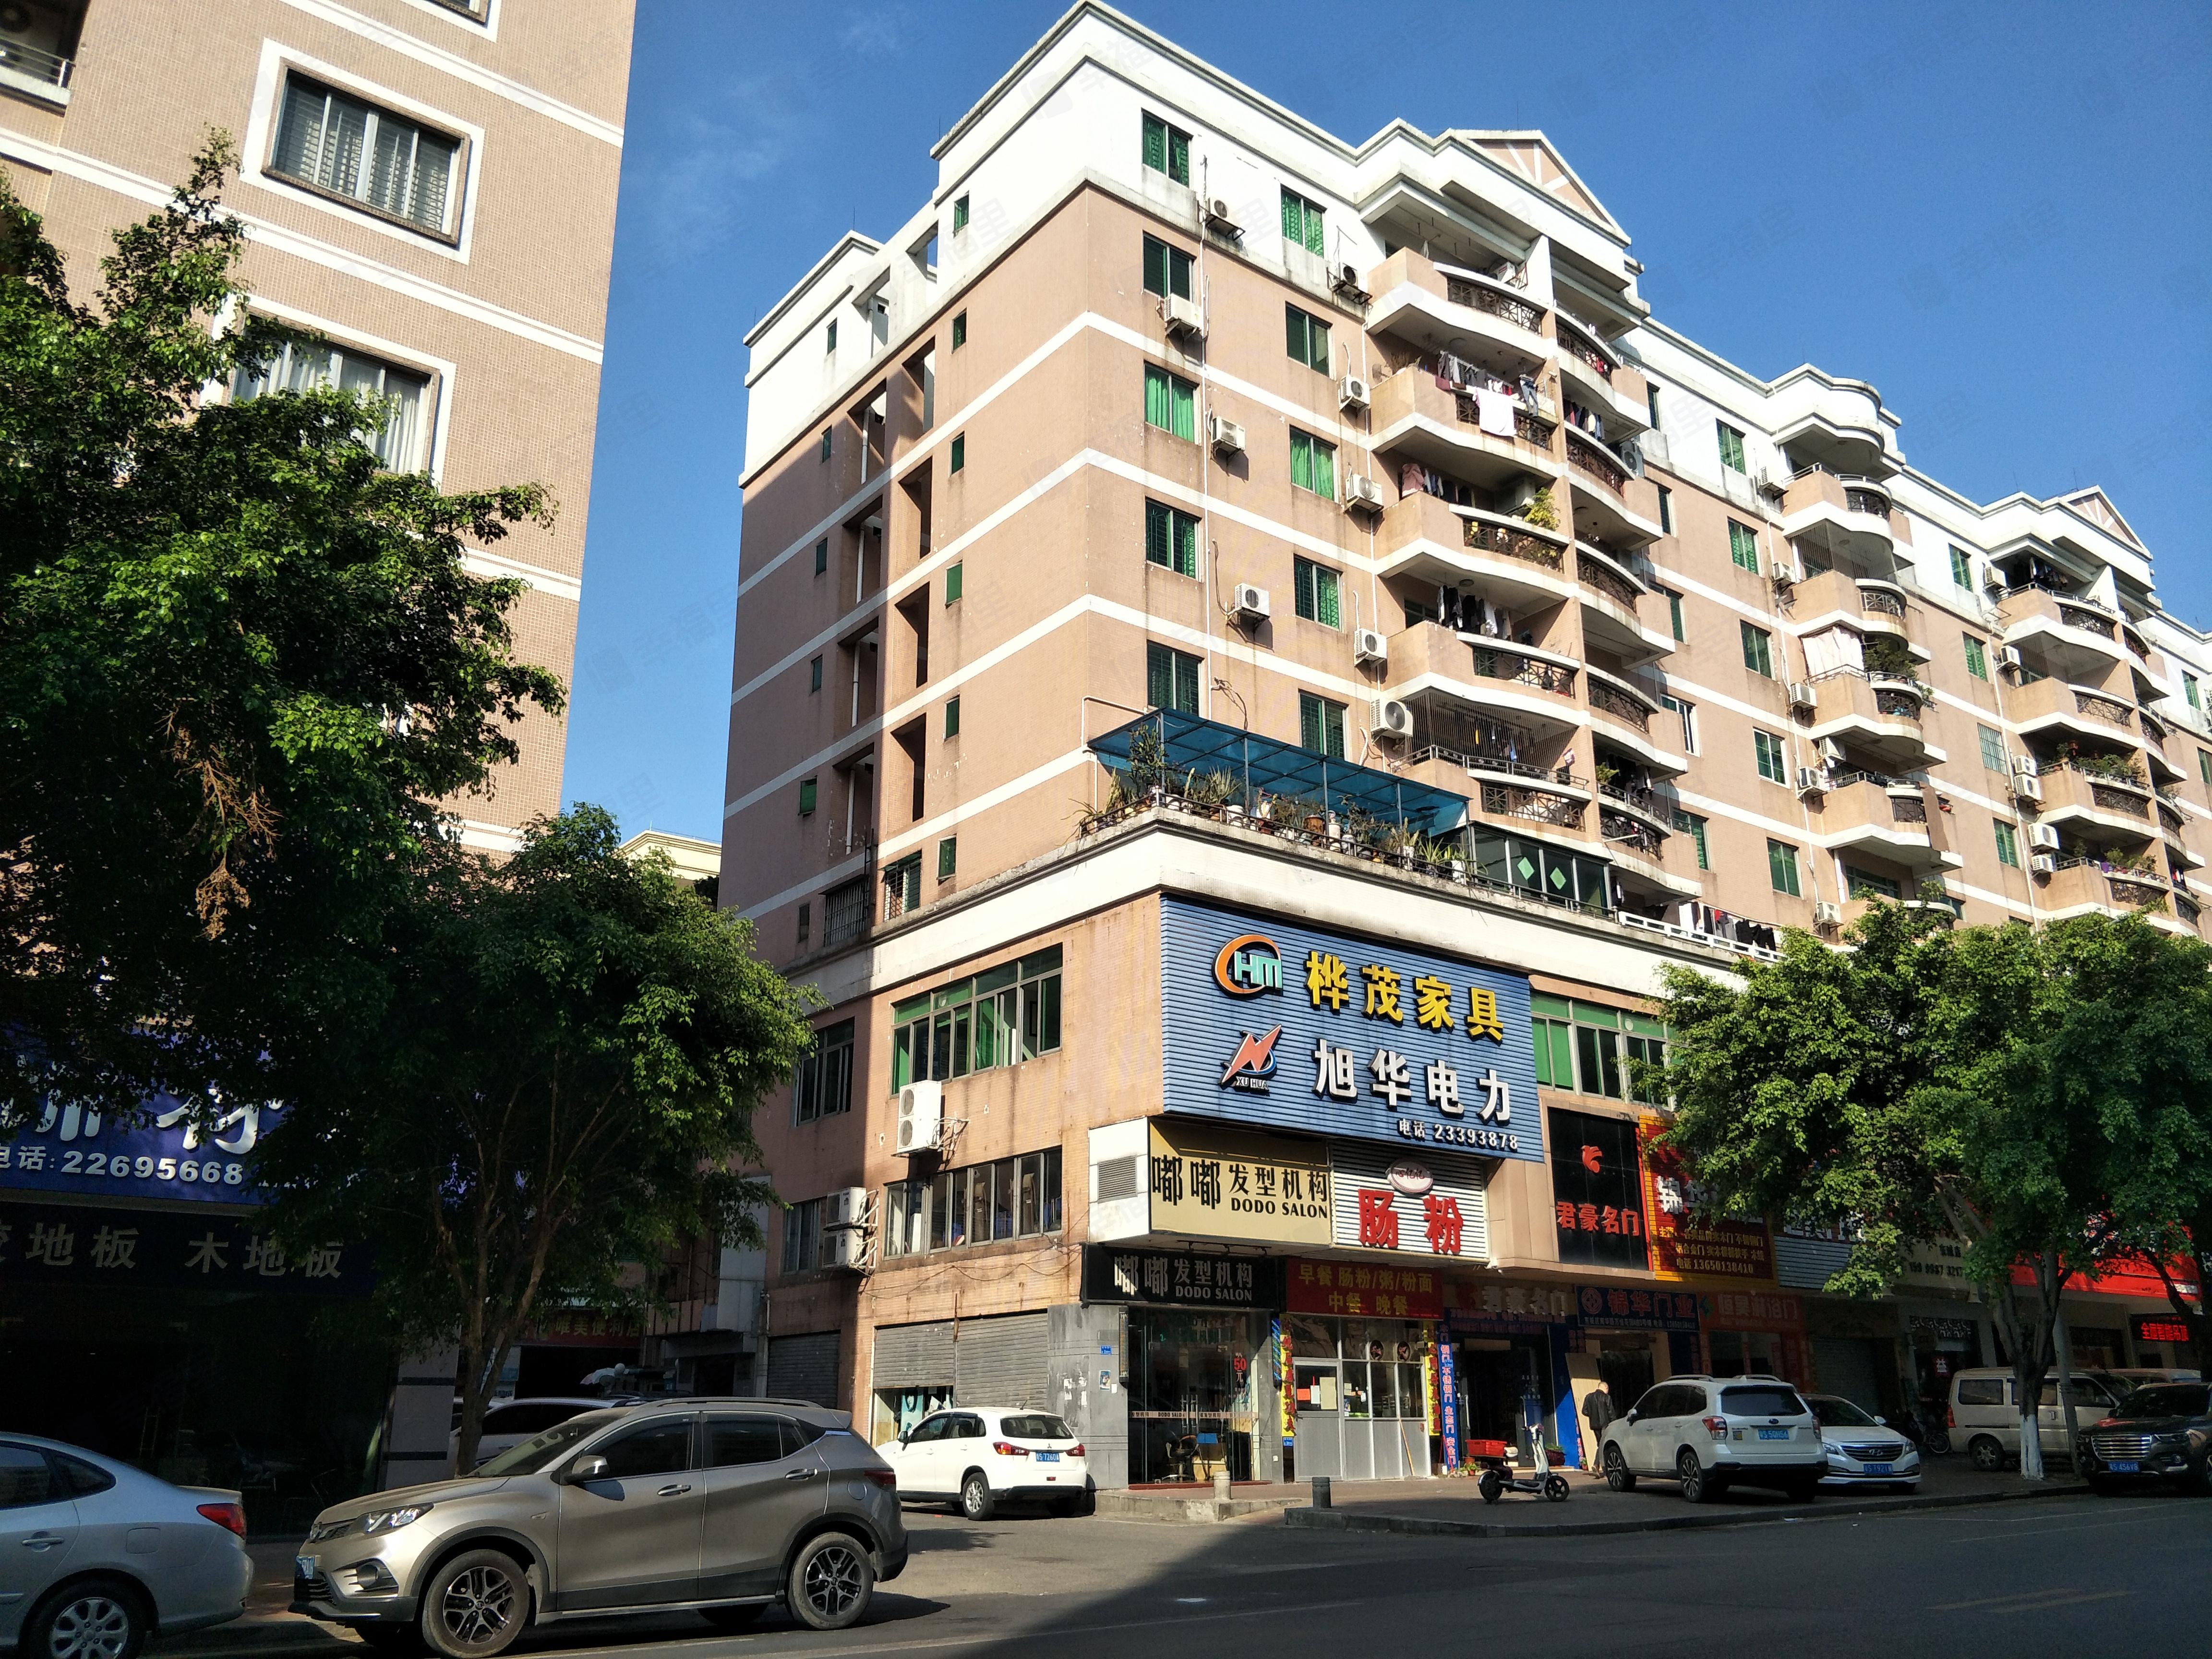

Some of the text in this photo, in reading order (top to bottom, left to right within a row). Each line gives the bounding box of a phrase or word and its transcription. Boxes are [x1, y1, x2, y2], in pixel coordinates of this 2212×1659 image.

[1306, 950, 1503, 1041] 桦茂家具
[1236, 1076, 1269, 1089] XU HUA
[1314, 1039, 1510, 1121] 旭华电力
[1399, 1118, 1518, 1149] 电话 23393878
[1152, 1154, 1327, 1209] 嘟嘟发型机构
[1231, 1197, 1328, 1219] DODO SALON
[1358, 1189, 1464, 1255] 肠粉
[1556, 1201, 1639, 1237] 君豪名门
[184, 1230, 344, 1279] 木地板
[1114, 1255, 1252, 1296] 嘟嘟发型机构
[1298, 1263, 1333, 1286] 早餐
[1174, 1285, 1252, 1301] DODO SALON
[1328, 1290, 1408, 1316] 中餐 晚餐
[1607, 1288, 1696, 1318] 锦华门业
